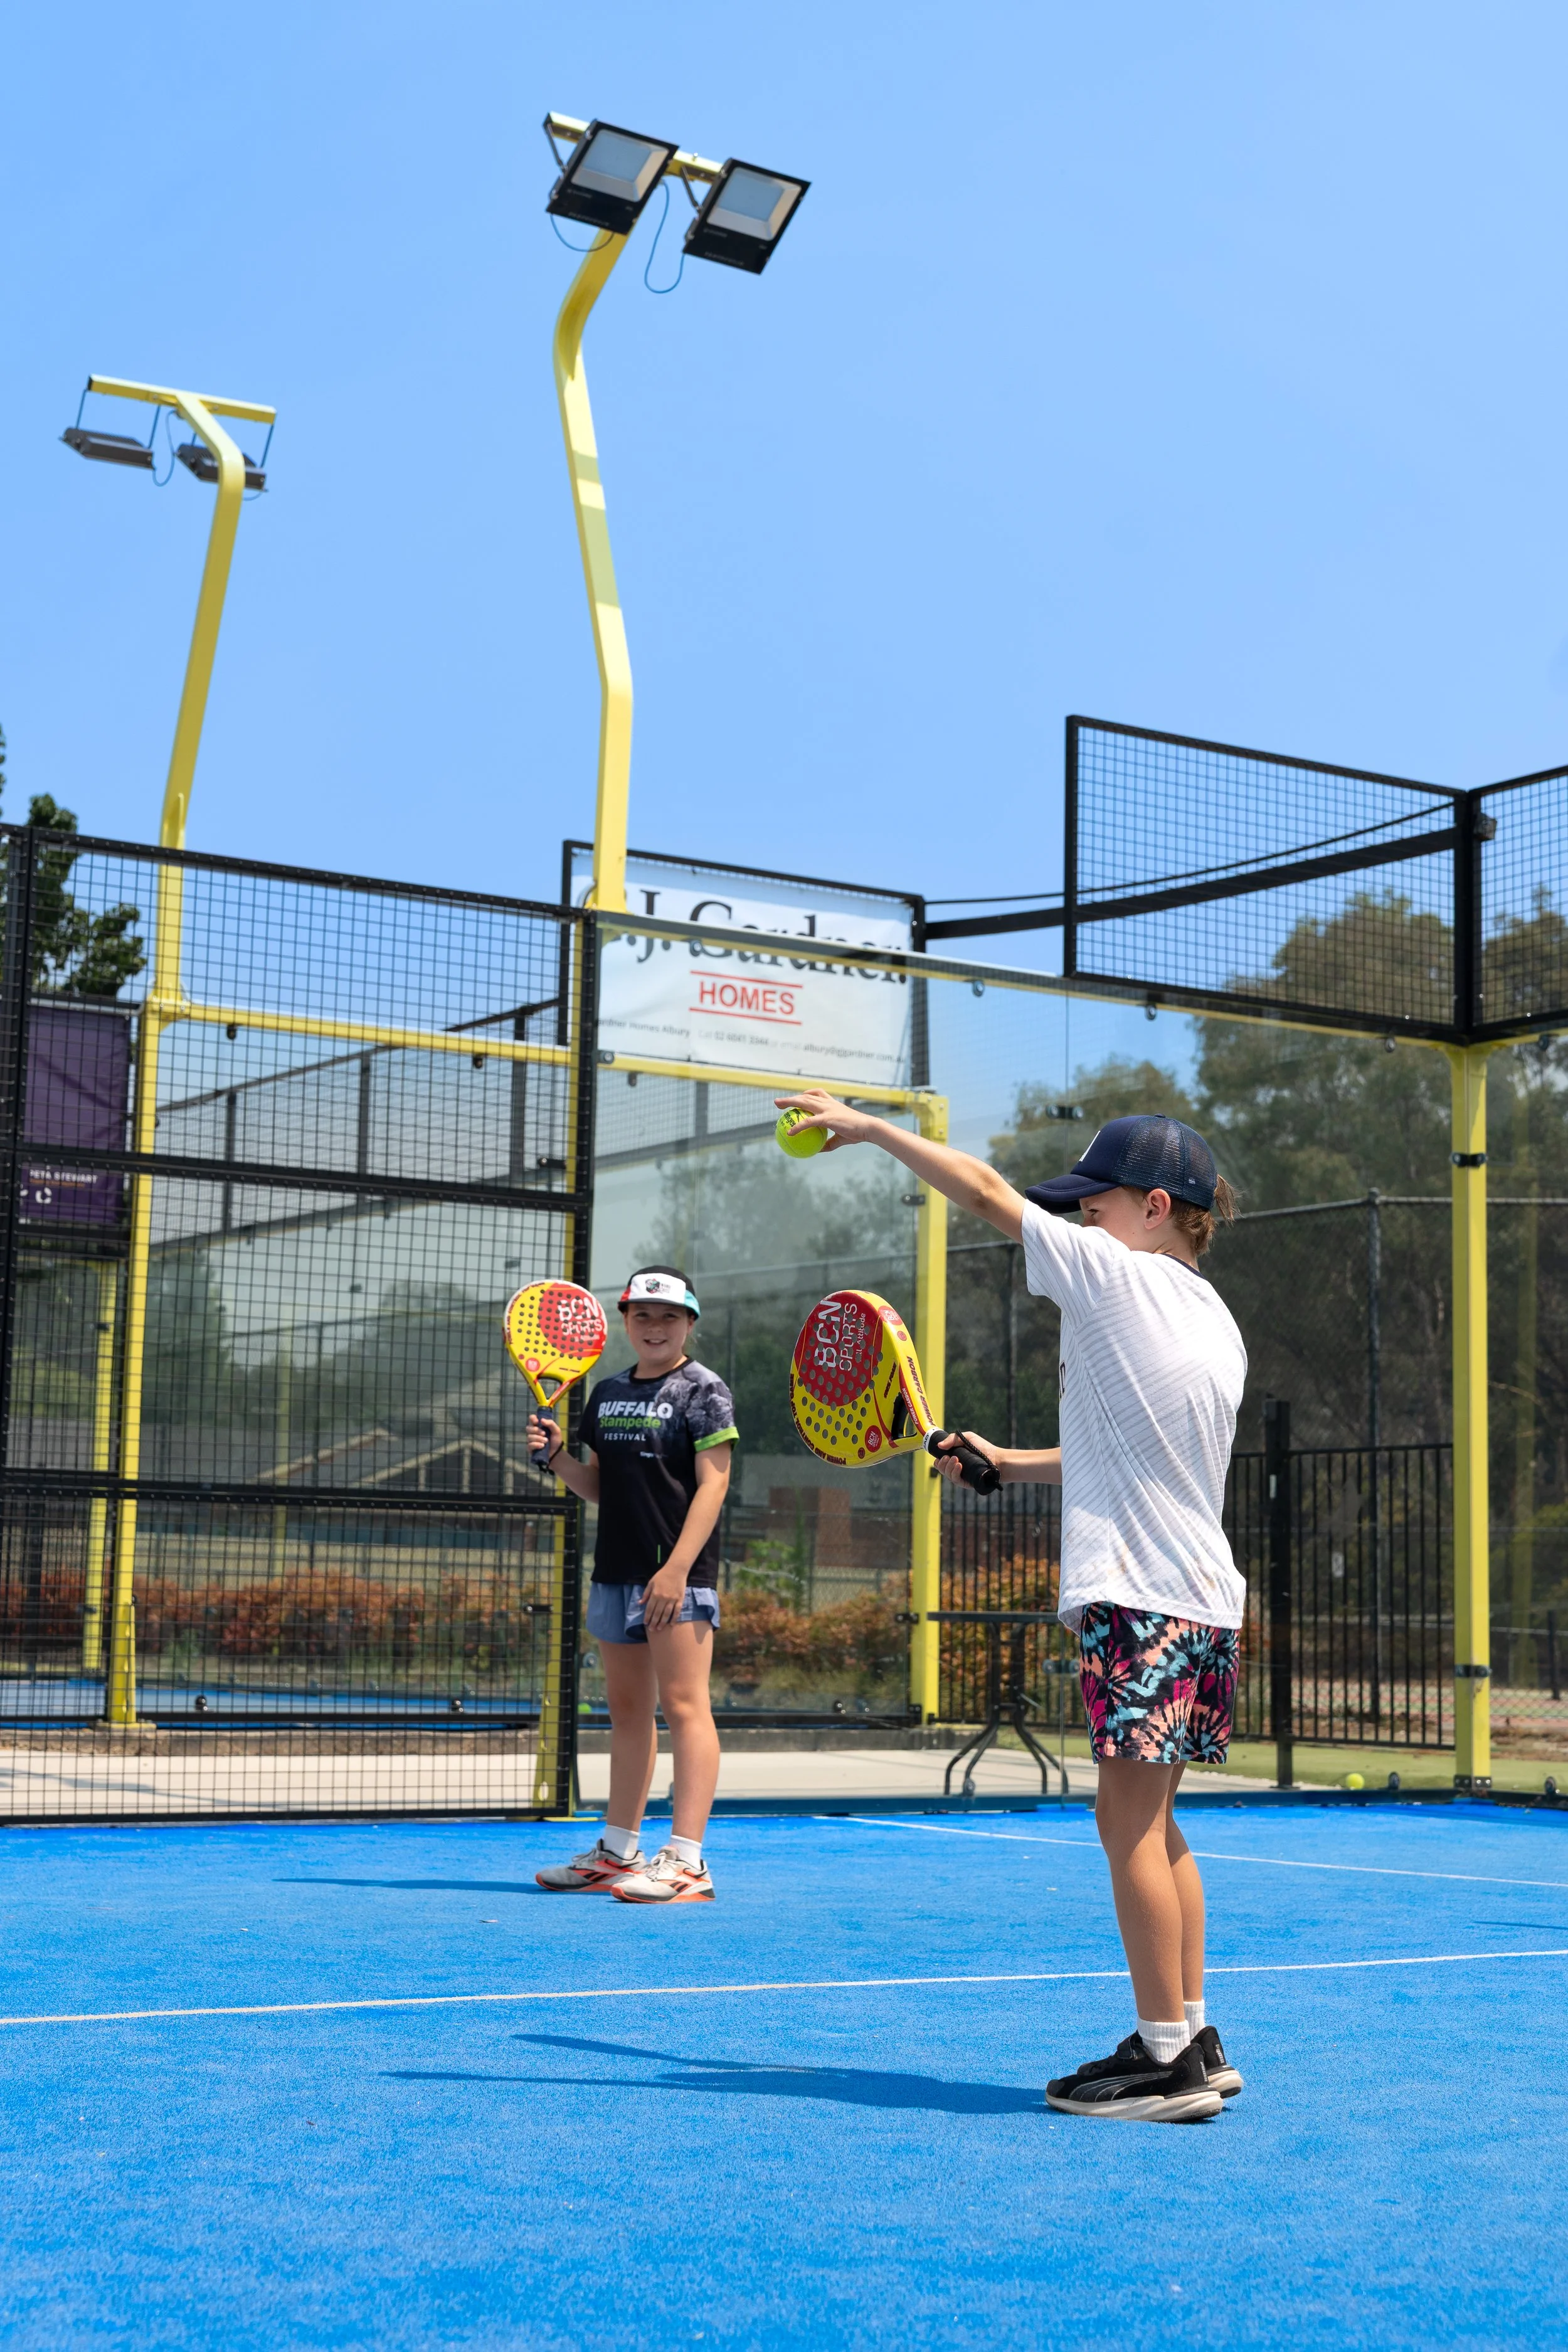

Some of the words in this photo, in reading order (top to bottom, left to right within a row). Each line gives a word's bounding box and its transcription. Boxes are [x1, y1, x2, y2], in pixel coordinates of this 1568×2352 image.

[699, 980, 795, 1015] HOMES
[629, 1022, 659, 1032] Homes
[662, 1025, 690, 1038] Albury
[29, 1169, 51, 1180] PETA
[53, 1171, 98, 1184] STEWART
[557, 1296, 600, 1322] BCN
[814, 1300, 842, 1368] BCN
[906, 1355, 923, 1395] CARBON
[902, 1387, 913, 1407] CARBON
[598, 1401, 674, 1419] BUFFALO
[909, 1407, 919, 1426] POWER
[920, 1395, 936, 1426] POWER
[600, 1415, 662, 1430] Stampede
[604, 1433, 647, 1441] FESTIVAL
[795, 1417, 815, 1452] CONTROL
[867, 1431, 876, 1446] BCN
[815, 1447, 827, 1460] AND
[827, 1453, 847, 1465] POWER
